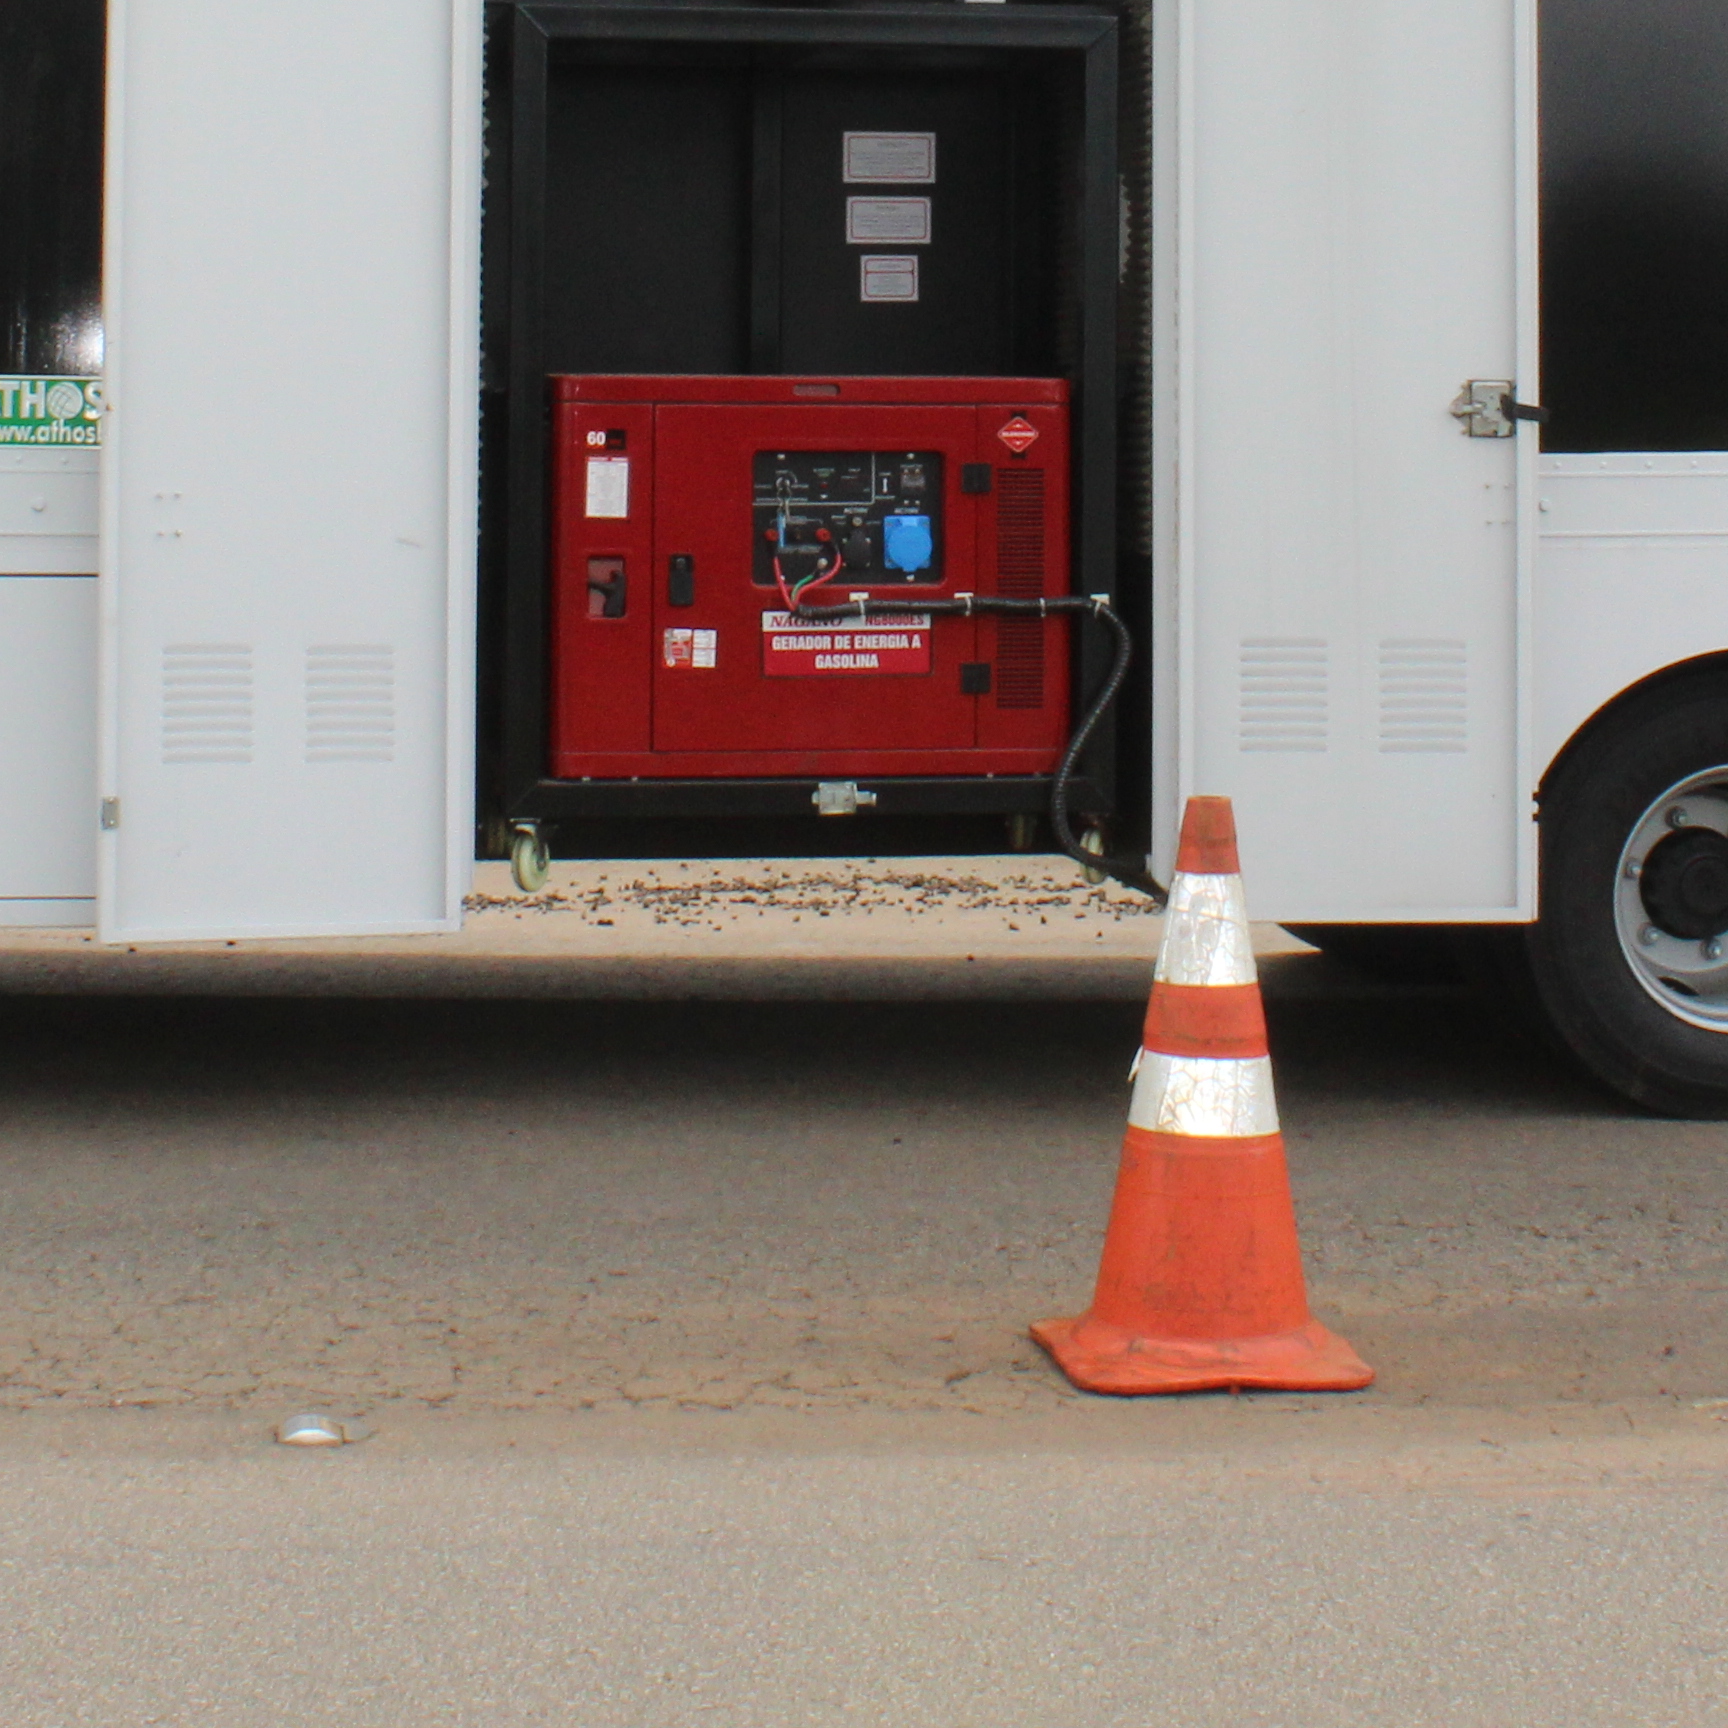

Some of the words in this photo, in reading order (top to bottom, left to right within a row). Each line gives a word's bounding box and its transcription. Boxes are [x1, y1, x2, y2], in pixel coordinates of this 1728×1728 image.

[771, 634, 832, 651] GERADOR
[833, 634, 852, 650] DE
[853, 633, 910, 650] ENERGIA
[911, 634, 922, 649] A
[814, 653, 879, 670] GASOLINA
